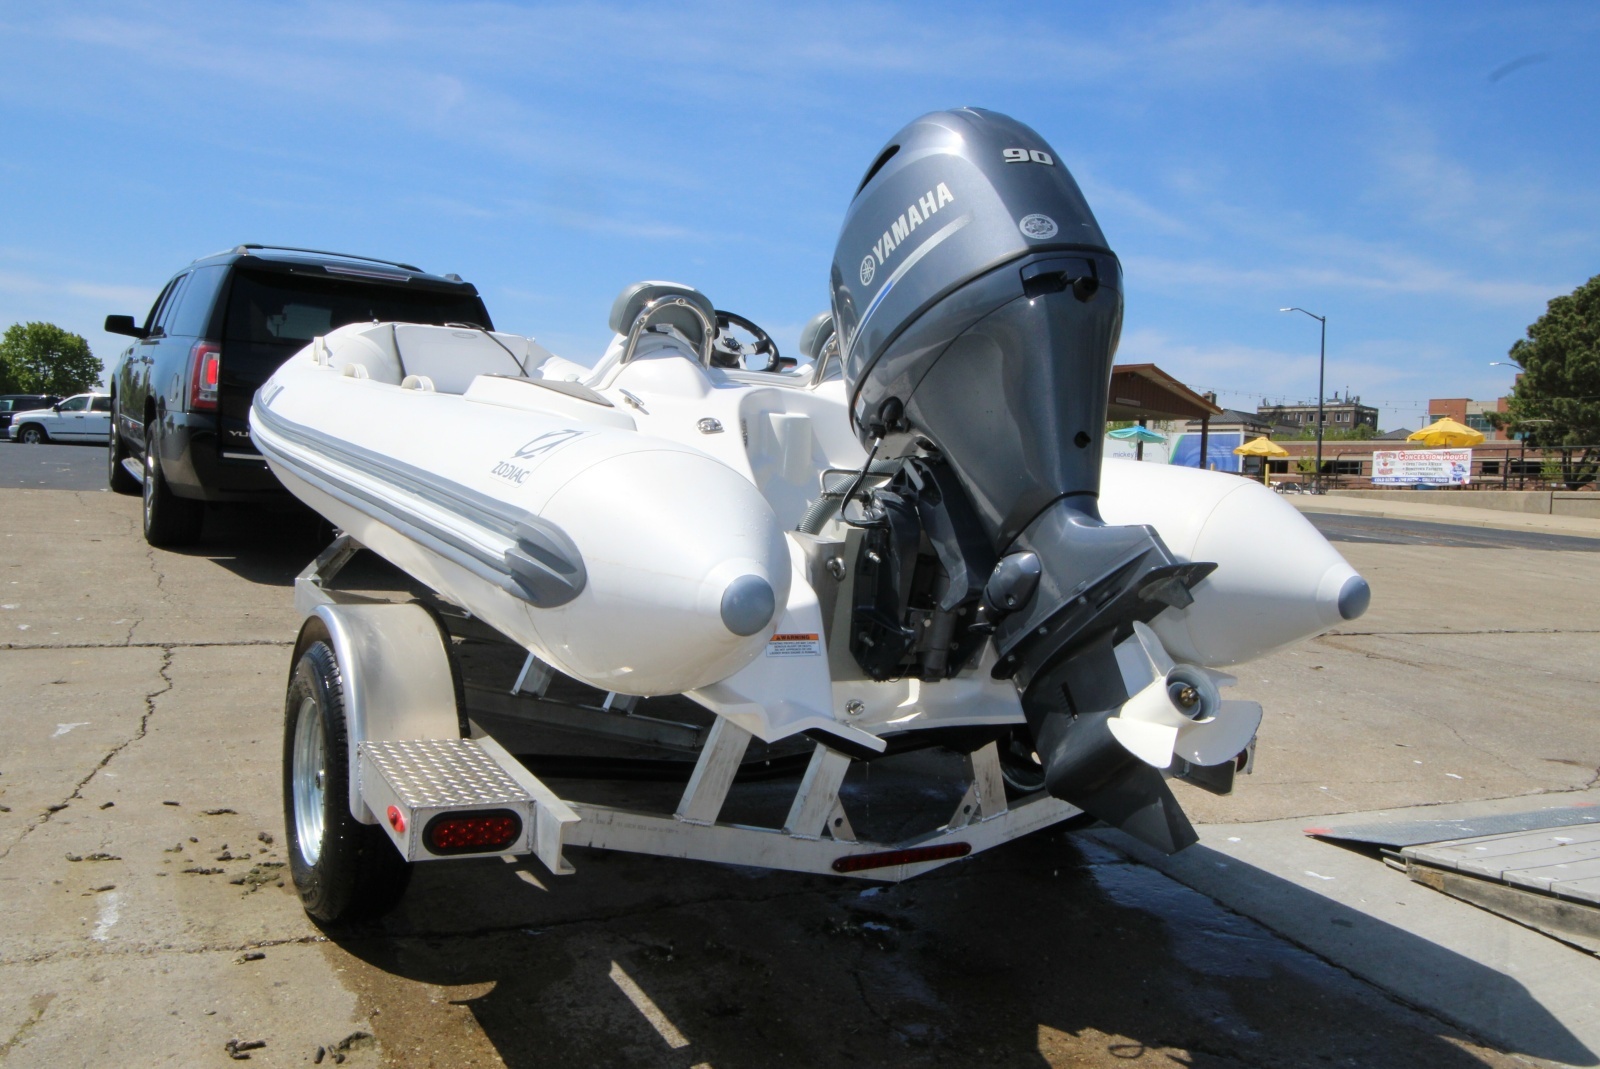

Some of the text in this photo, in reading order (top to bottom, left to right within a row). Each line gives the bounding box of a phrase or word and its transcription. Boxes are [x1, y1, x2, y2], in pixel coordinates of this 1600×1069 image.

[1003, 148, 1054, 166] 90
[872, 182, 955, 266] YAMAHA
[1398, 451, 1443, 461] CONCESSION
[1443, 451, 1468, 461] HOUSE
[491, 460, 531, 484] ZODIAC
